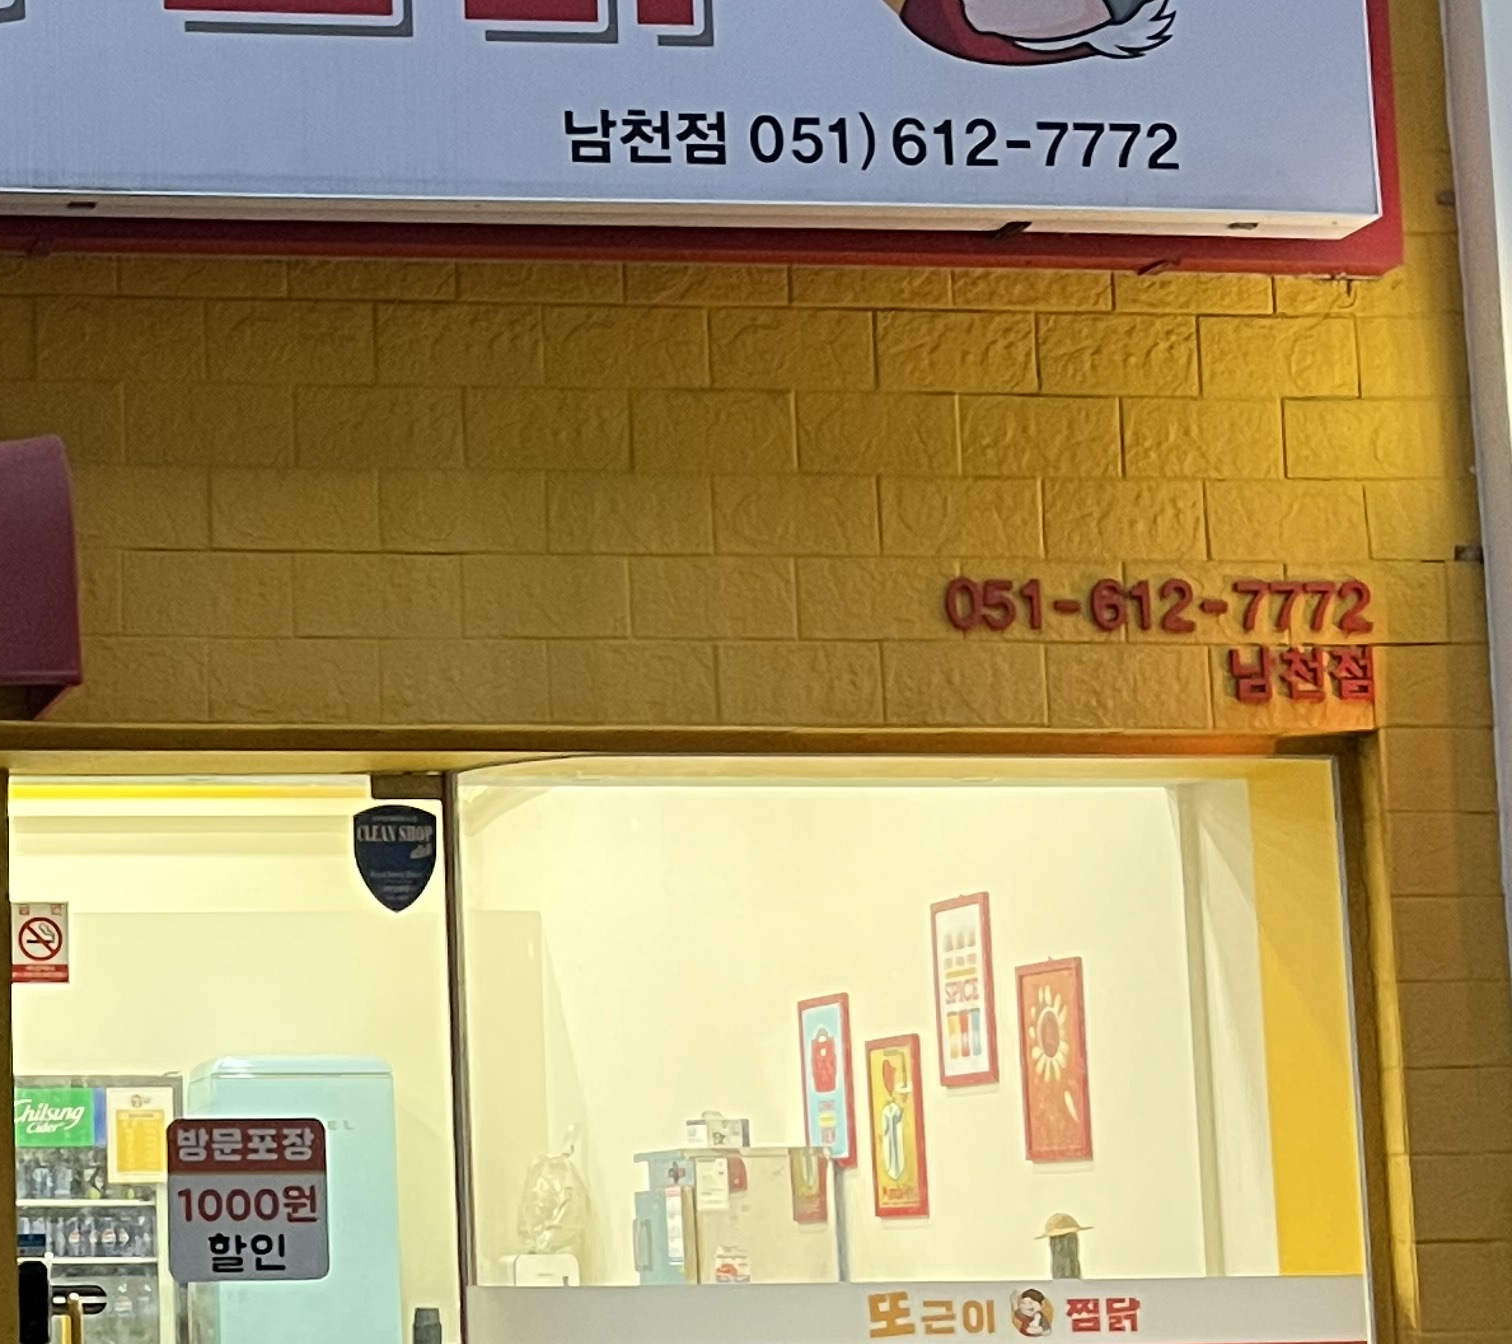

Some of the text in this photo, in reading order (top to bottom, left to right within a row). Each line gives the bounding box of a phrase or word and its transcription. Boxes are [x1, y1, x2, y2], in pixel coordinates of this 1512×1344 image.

[563, 108, 730, 167] 남천점
[944, 576, 1374, 634] 051-612-7772
[1227, 644, 1374, 703] 남천점
[356, 825, 433, 842] CLEAN SHOP
[944, 977, 979, 1005] SPICE
[175, 1126, 316, 1164] 방문포장
[177, 1185, 320, 1225] 1000원
[207, 1232, 287, 1273] 할인
[867, 1291, 1141, 1338] 또근이 찜닭
